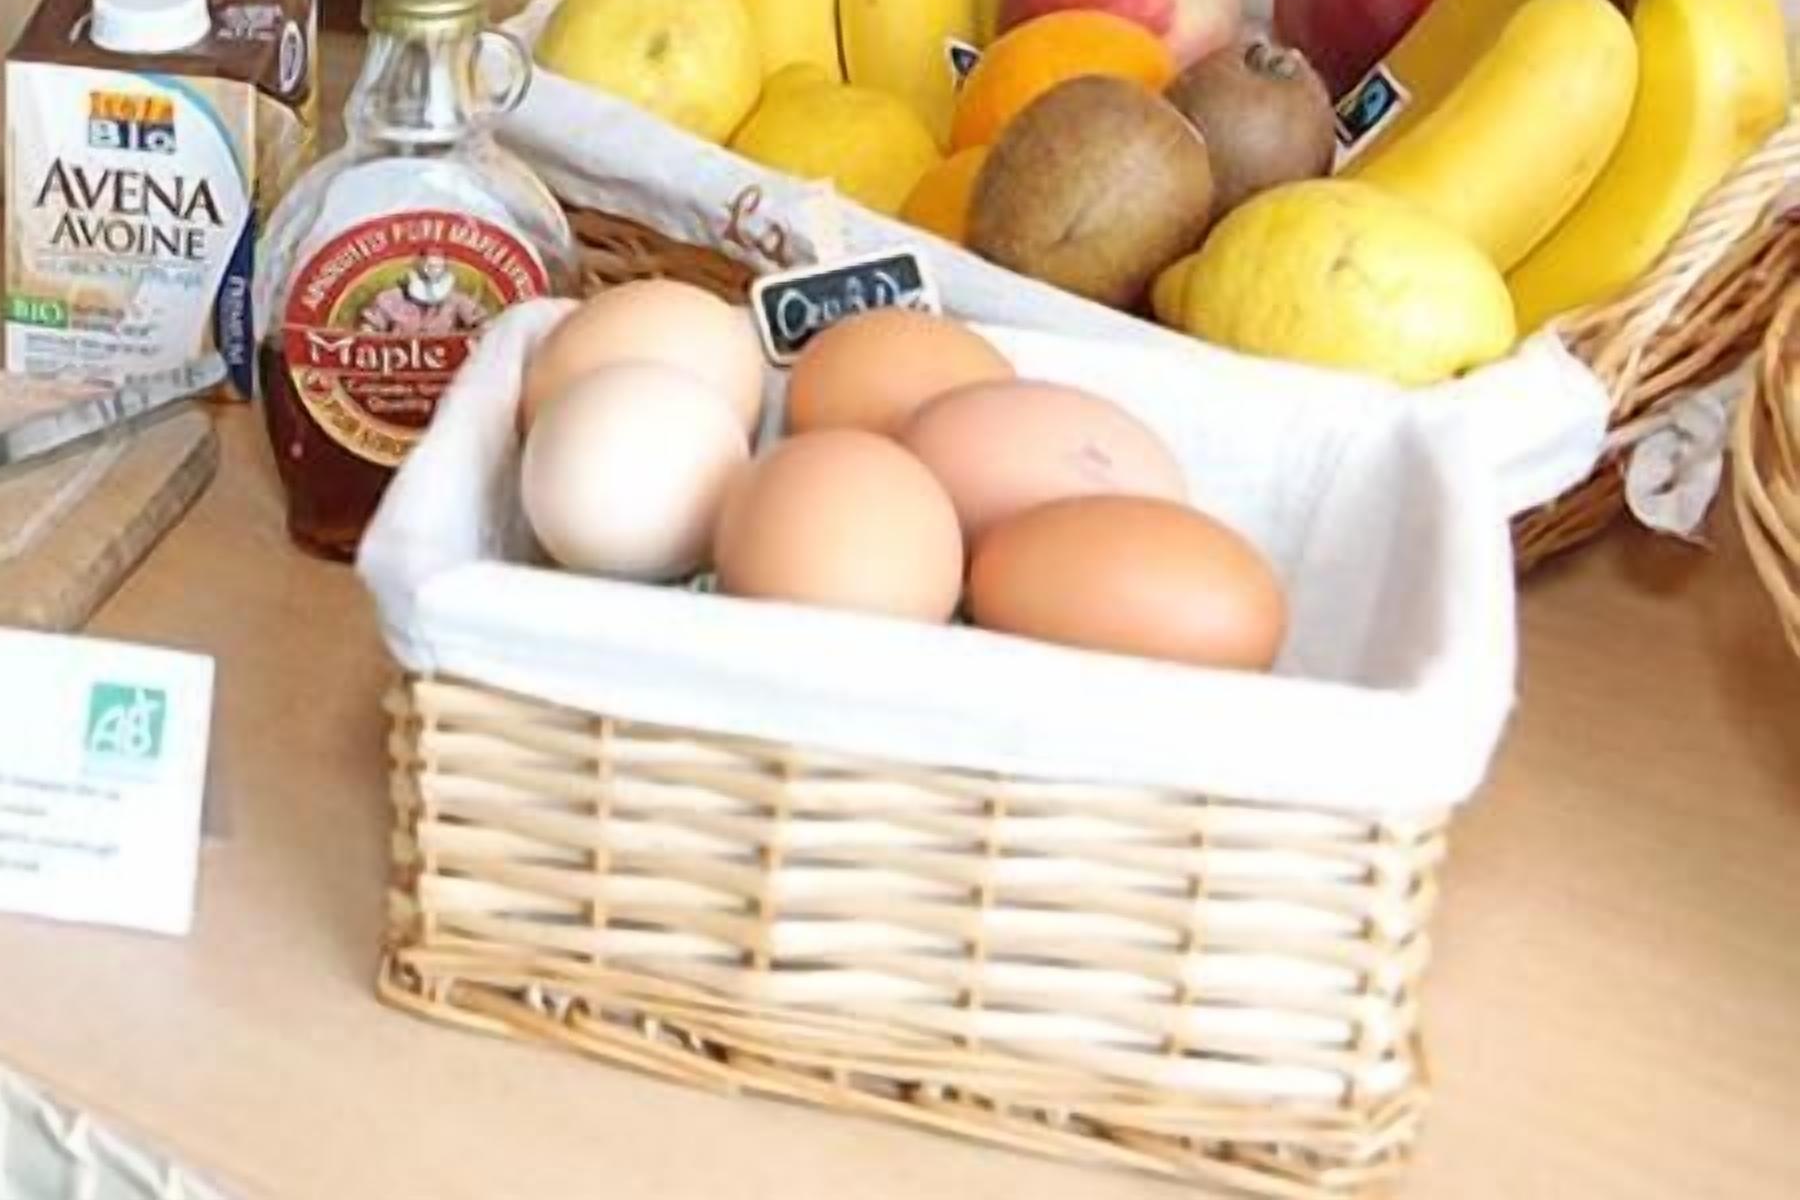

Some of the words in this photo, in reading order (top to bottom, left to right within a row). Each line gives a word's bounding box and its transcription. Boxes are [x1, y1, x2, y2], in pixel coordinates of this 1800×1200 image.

[36, 157, 225, 226] AVENA
[51, 213, 206, 260] AVOINE
[307, 331, 448, 377] Maple
